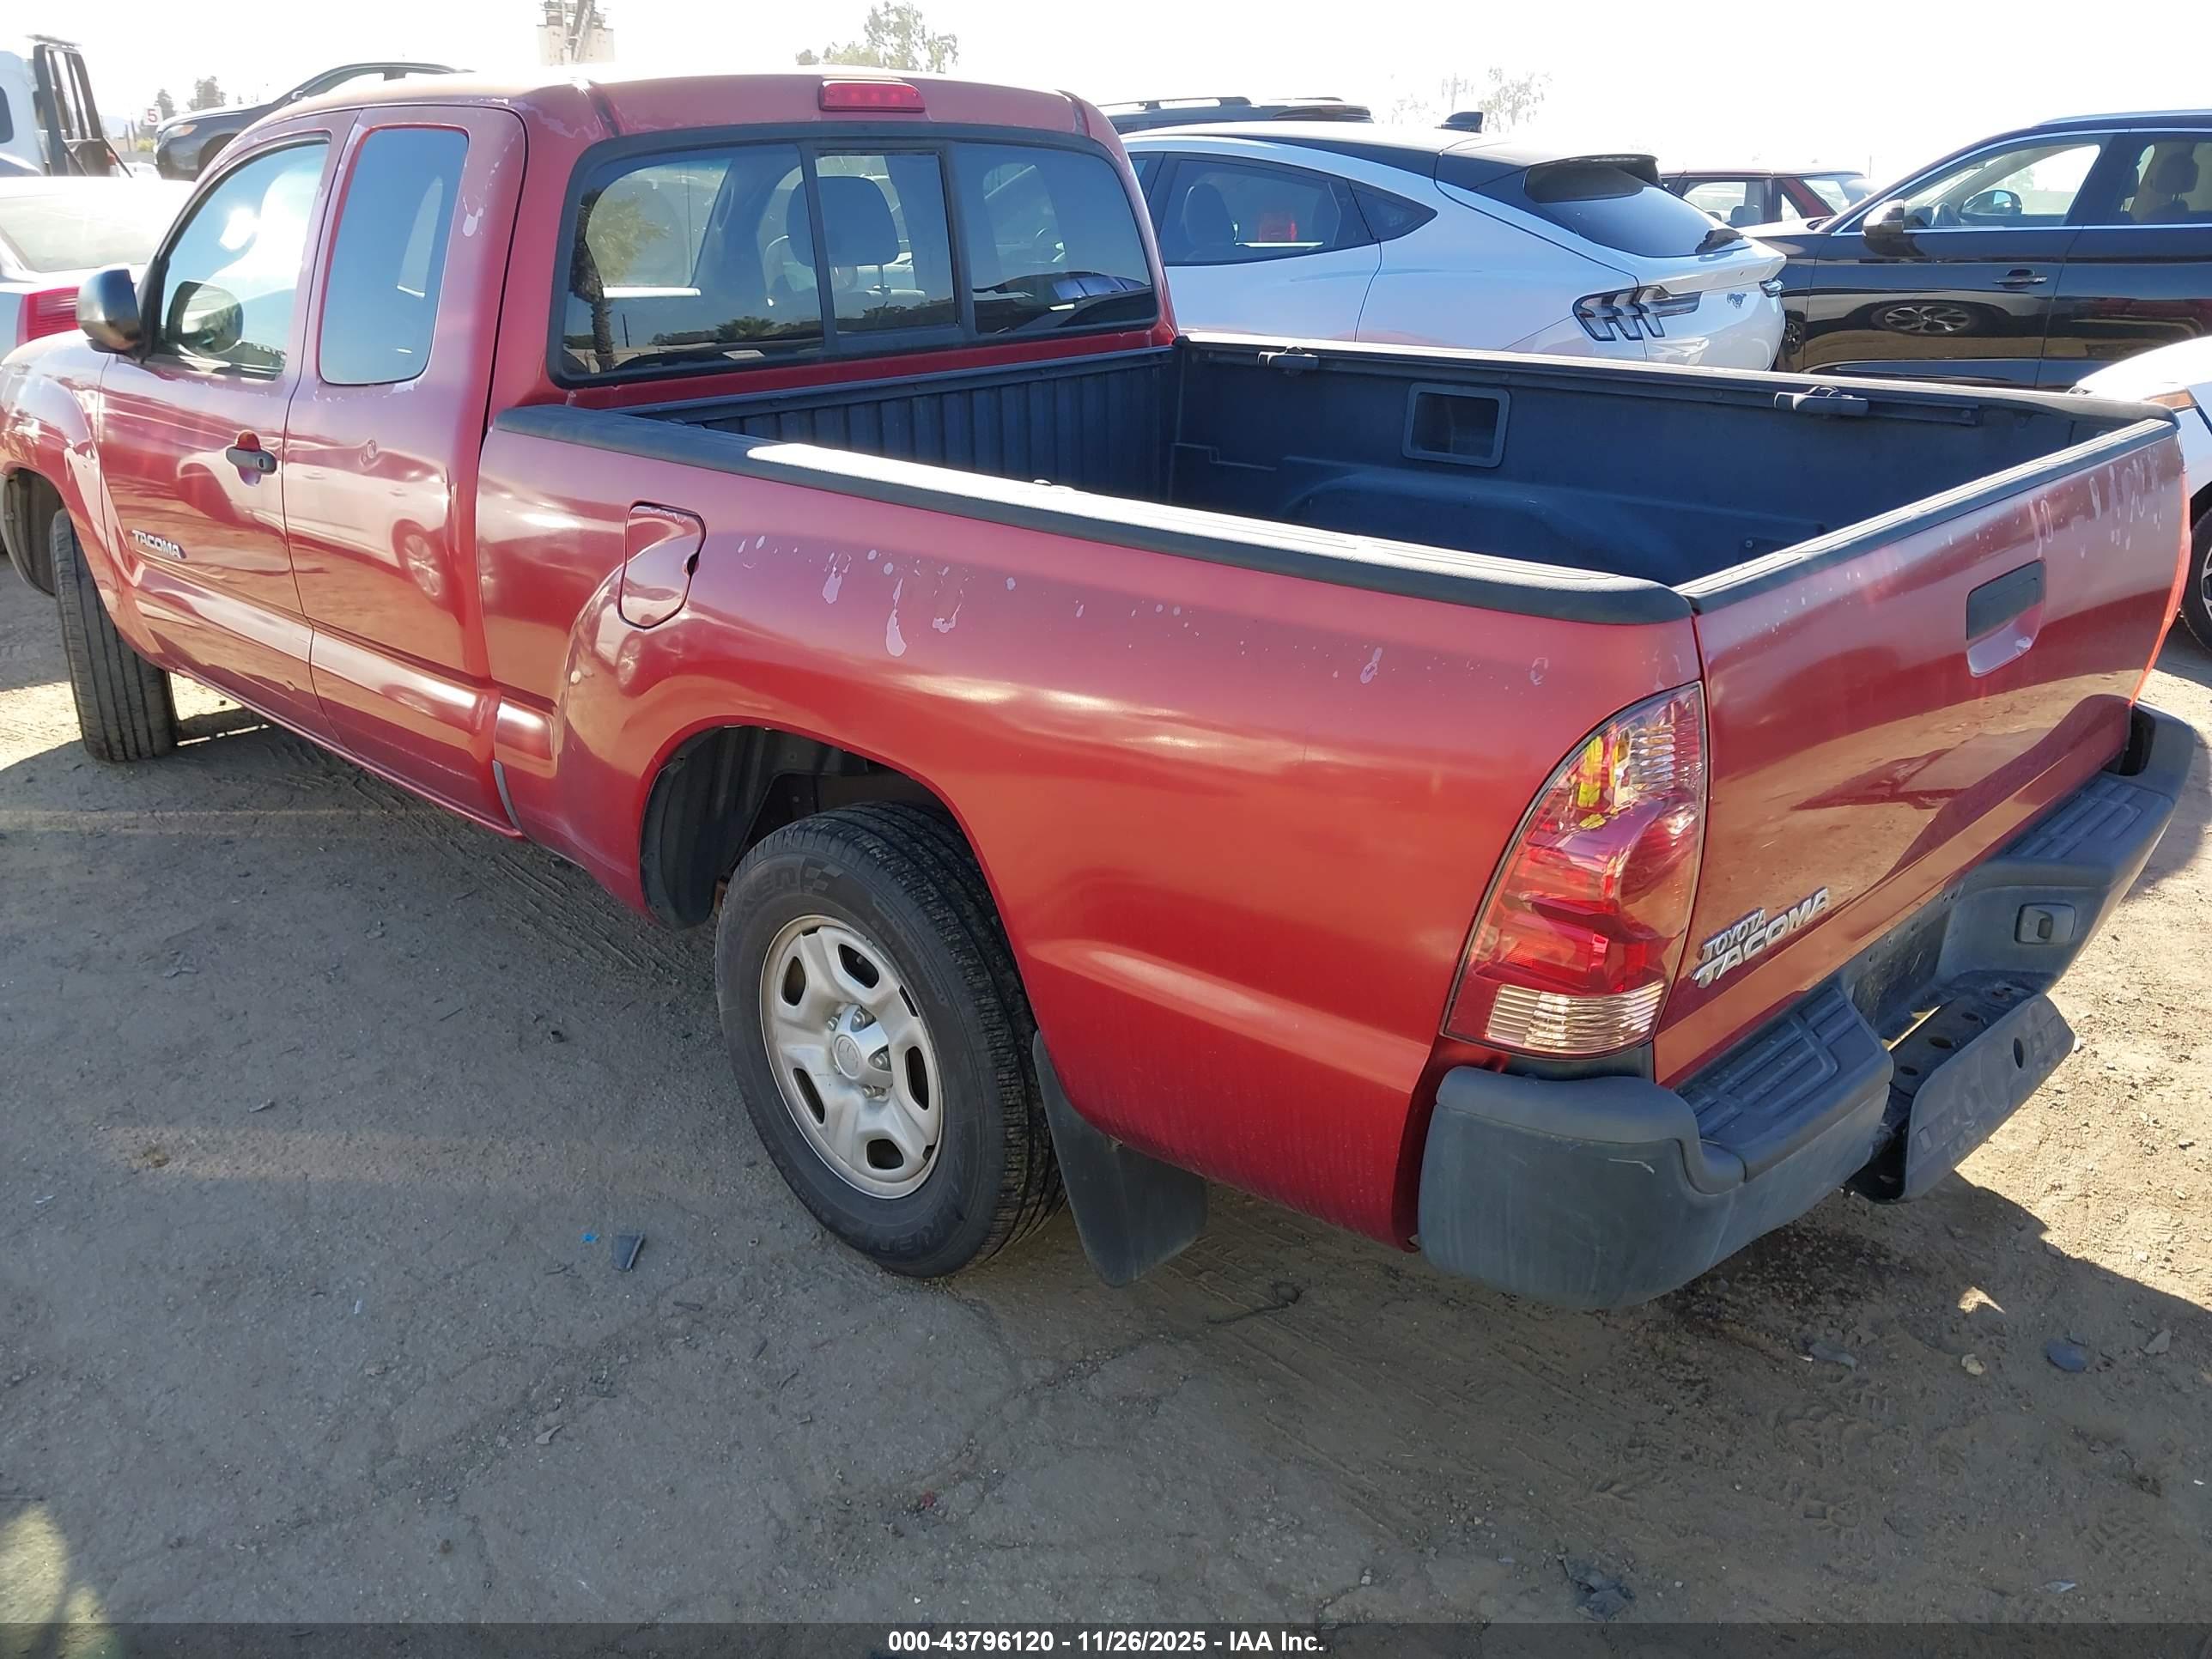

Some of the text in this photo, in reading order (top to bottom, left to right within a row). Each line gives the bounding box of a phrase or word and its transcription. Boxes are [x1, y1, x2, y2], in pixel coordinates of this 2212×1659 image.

[147, 108, 158, 123] 5
[131, 529, 182, 560] TACOMA
[1691, 886, 1828, 988] TACOMA
[1701, 907, 1766, 962] TOYOTA
